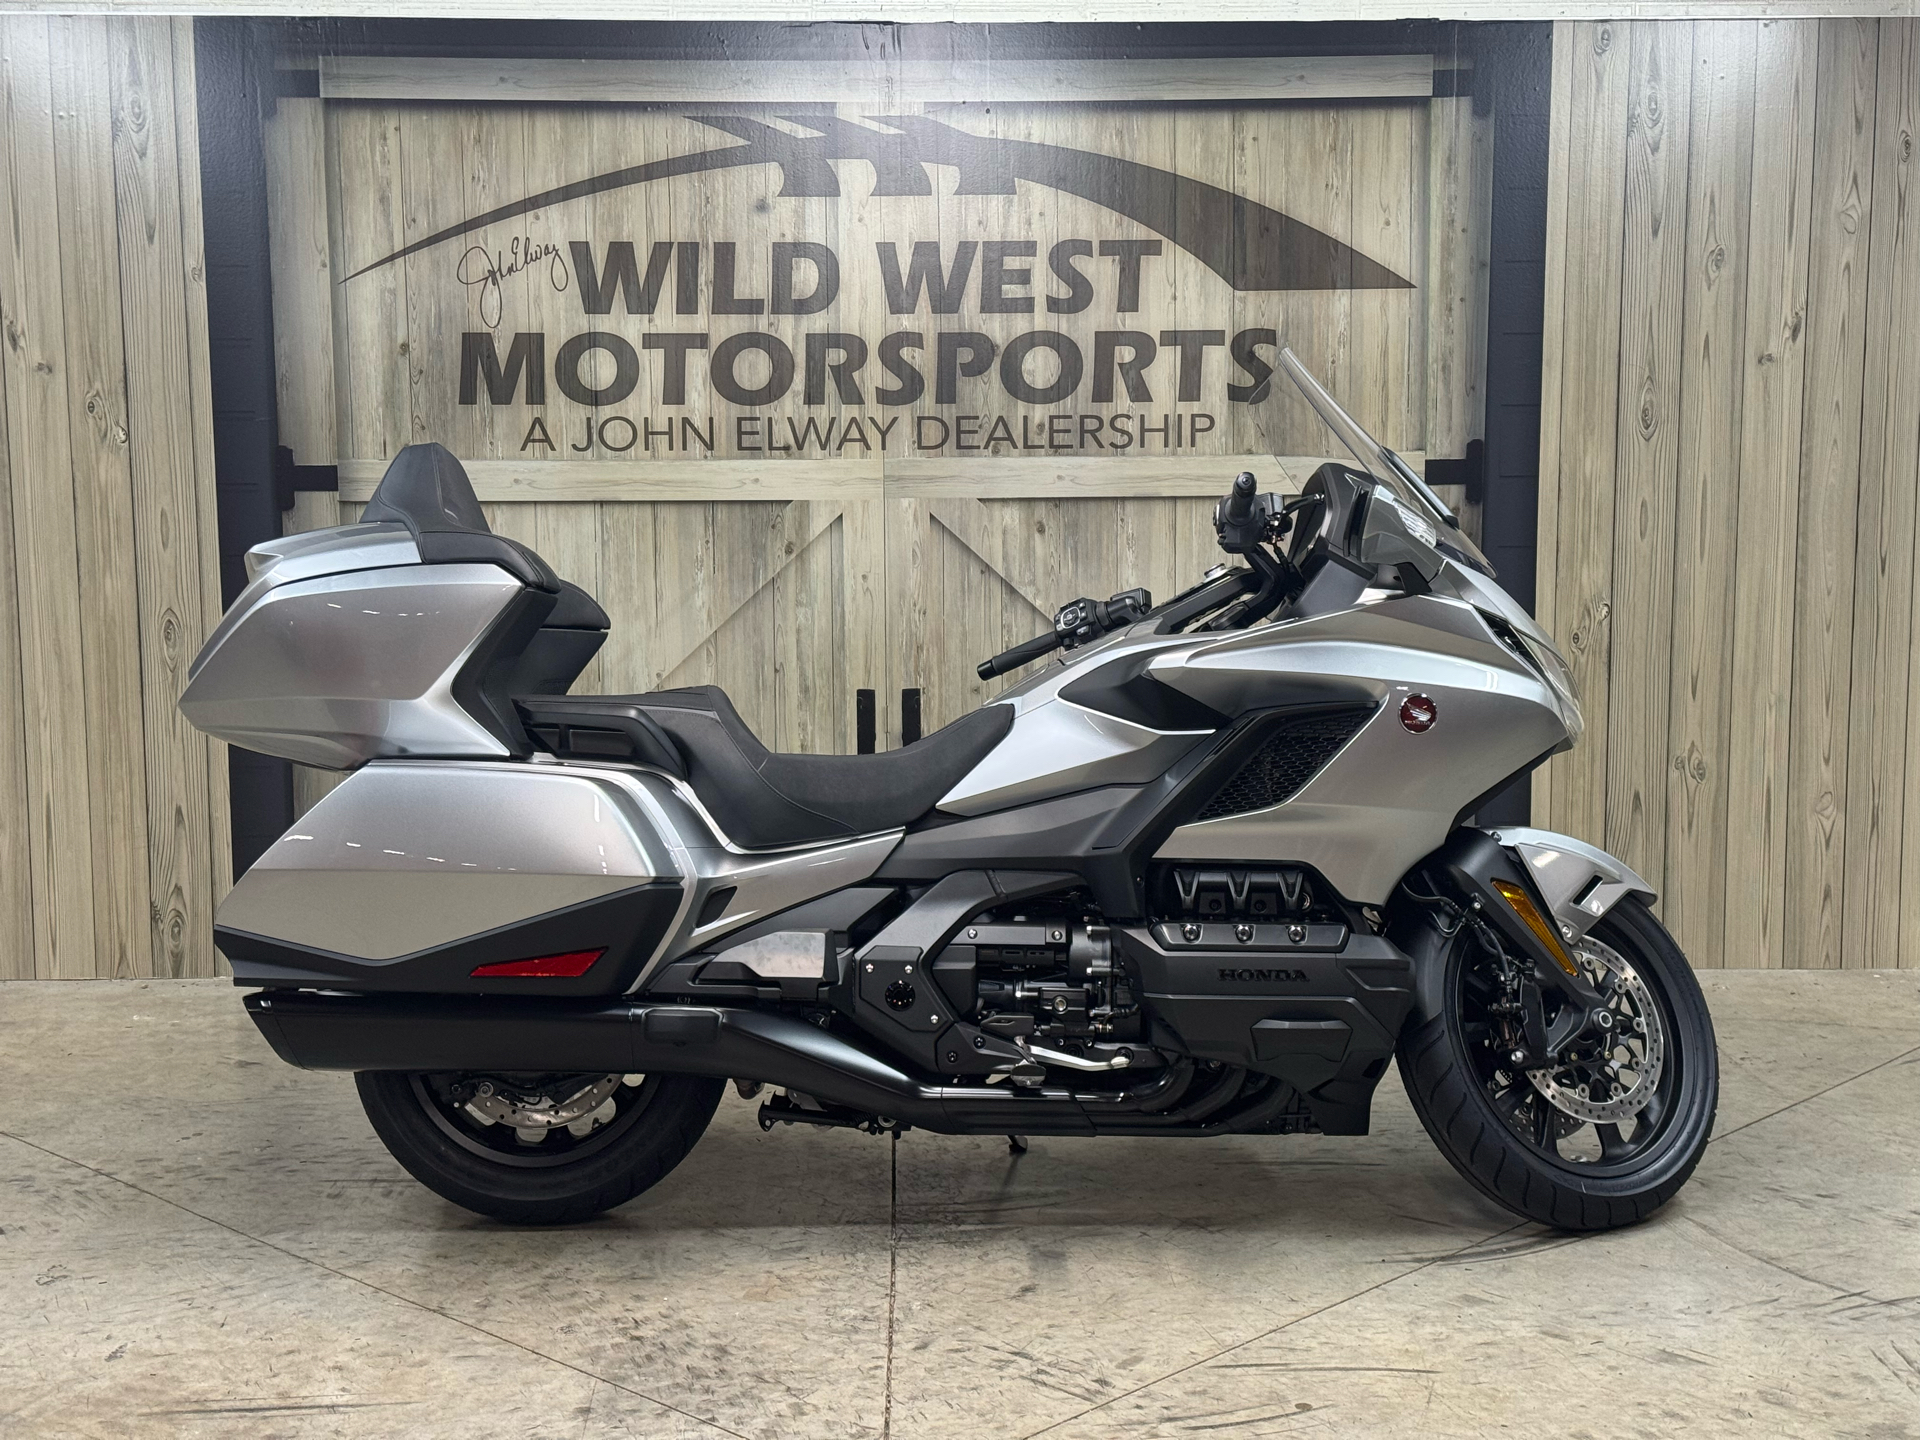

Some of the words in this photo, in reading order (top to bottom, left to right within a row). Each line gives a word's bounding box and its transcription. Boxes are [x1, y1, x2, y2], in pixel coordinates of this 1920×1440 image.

[568, 241, 840, 315] WILD
[875, 238, 1163, 315] WEST
[458, 328, 1277, 407] MOTORSPORTS
[520, 417, 557, 452] A
[571, 415, 714, 452] JOHN
[737, 415, 900, 451] ELWAY
[916, 413, 1216, 451] DEALERSHIP
[1216, 968, 1310, 983] HONDA
